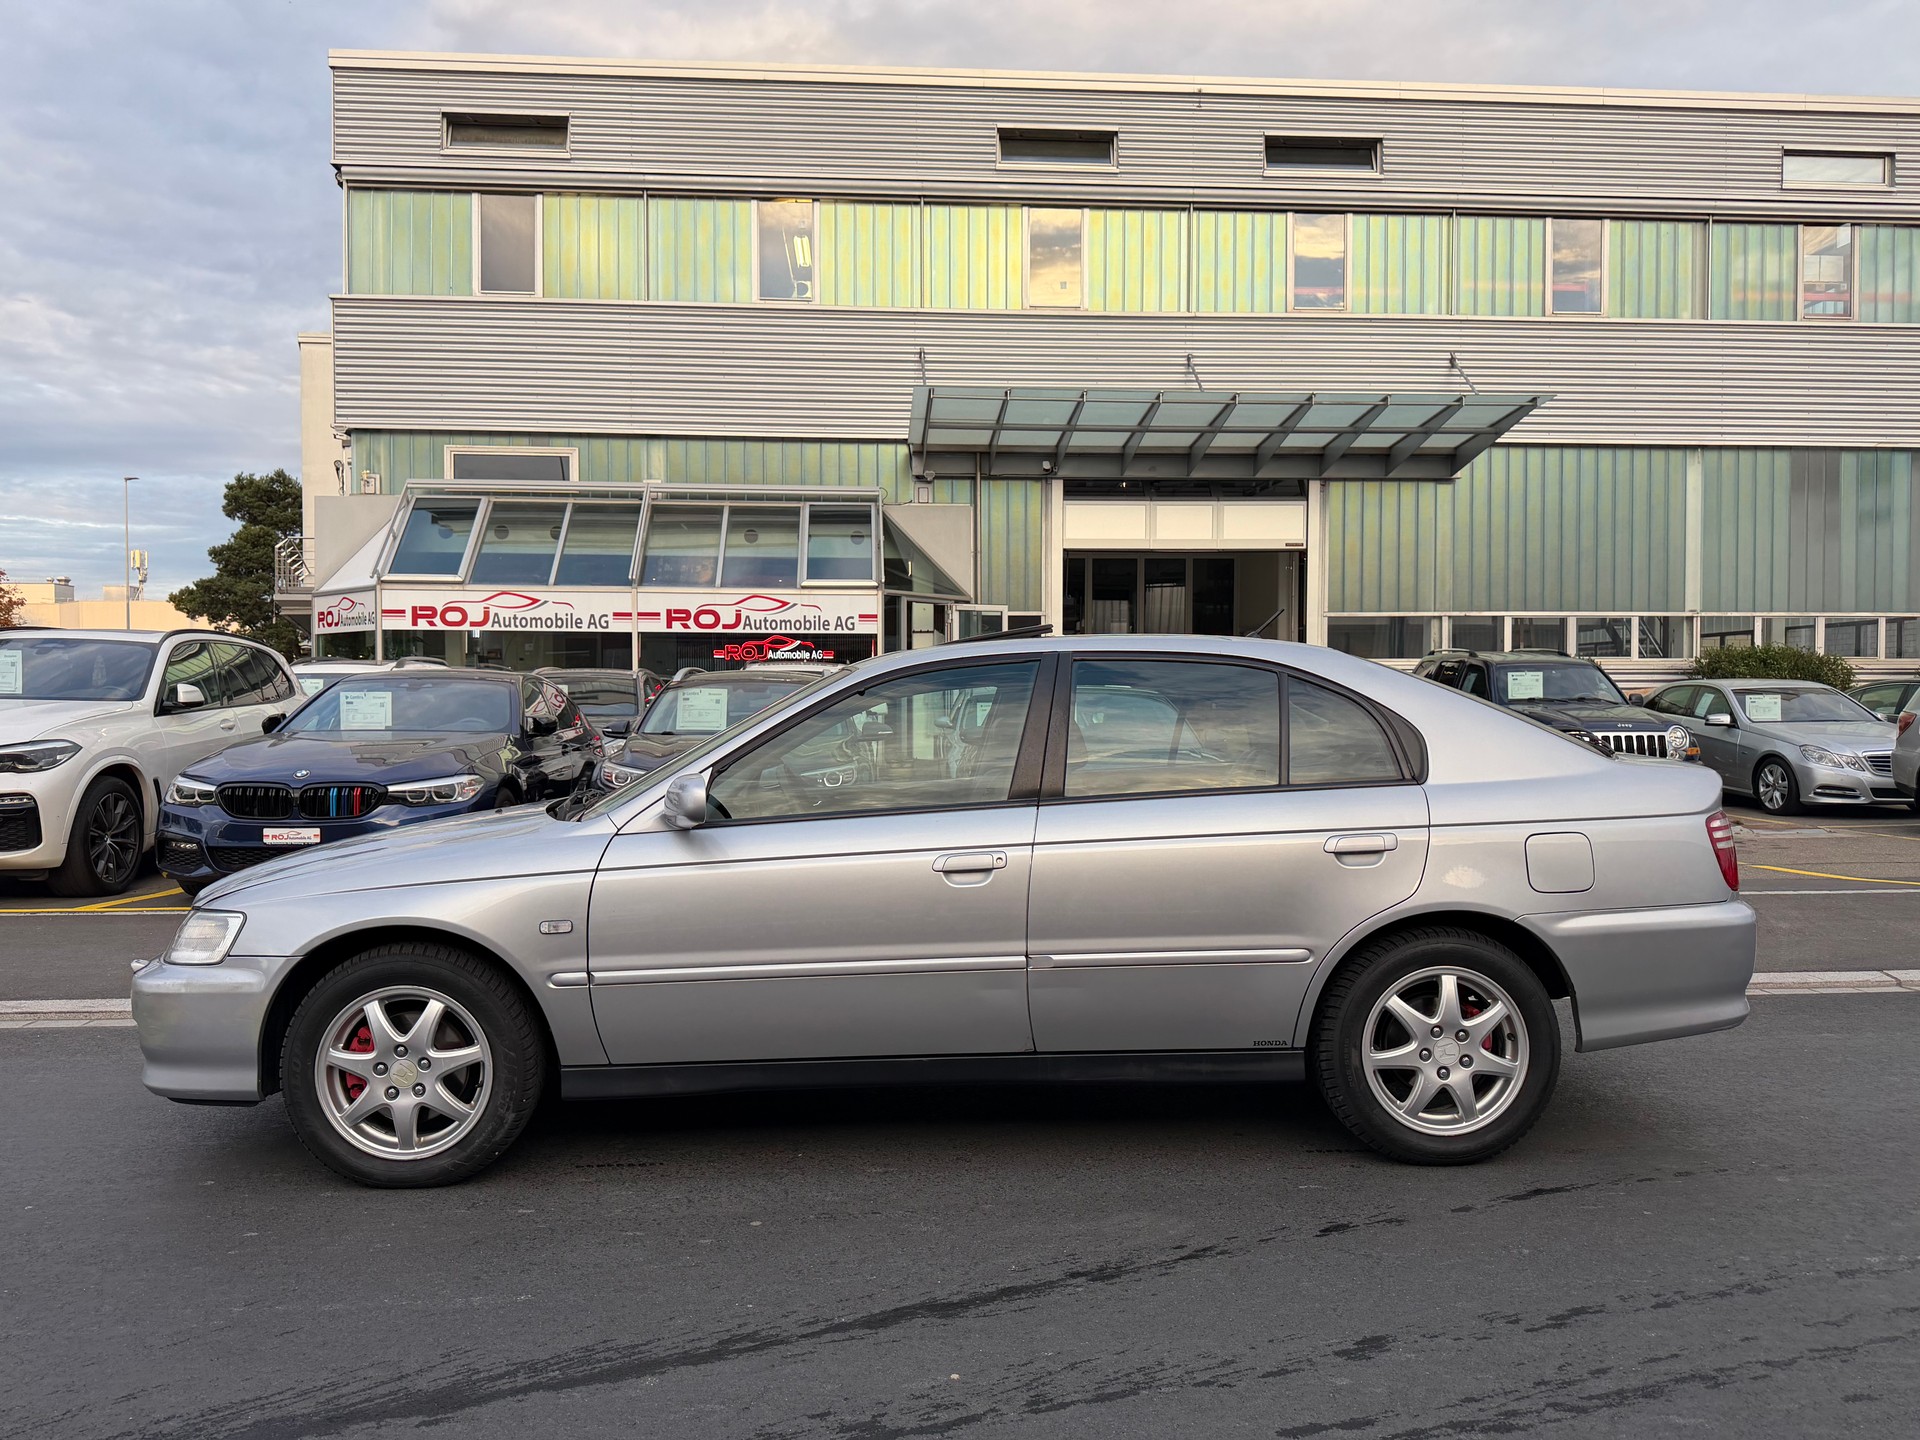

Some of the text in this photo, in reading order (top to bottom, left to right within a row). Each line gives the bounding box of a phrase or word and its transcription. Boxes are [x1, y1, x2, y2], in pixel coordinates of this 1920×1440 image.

[317, 610, 340, 628] ROJ
[340, 612, 367, 627] Automobile
[411, 606, 609, 629] ROJ Automobile AG
[666, 608, 855, 631] ROJ Automobile AG
[725, 644, 823, 661] ROJ Automobile AG
